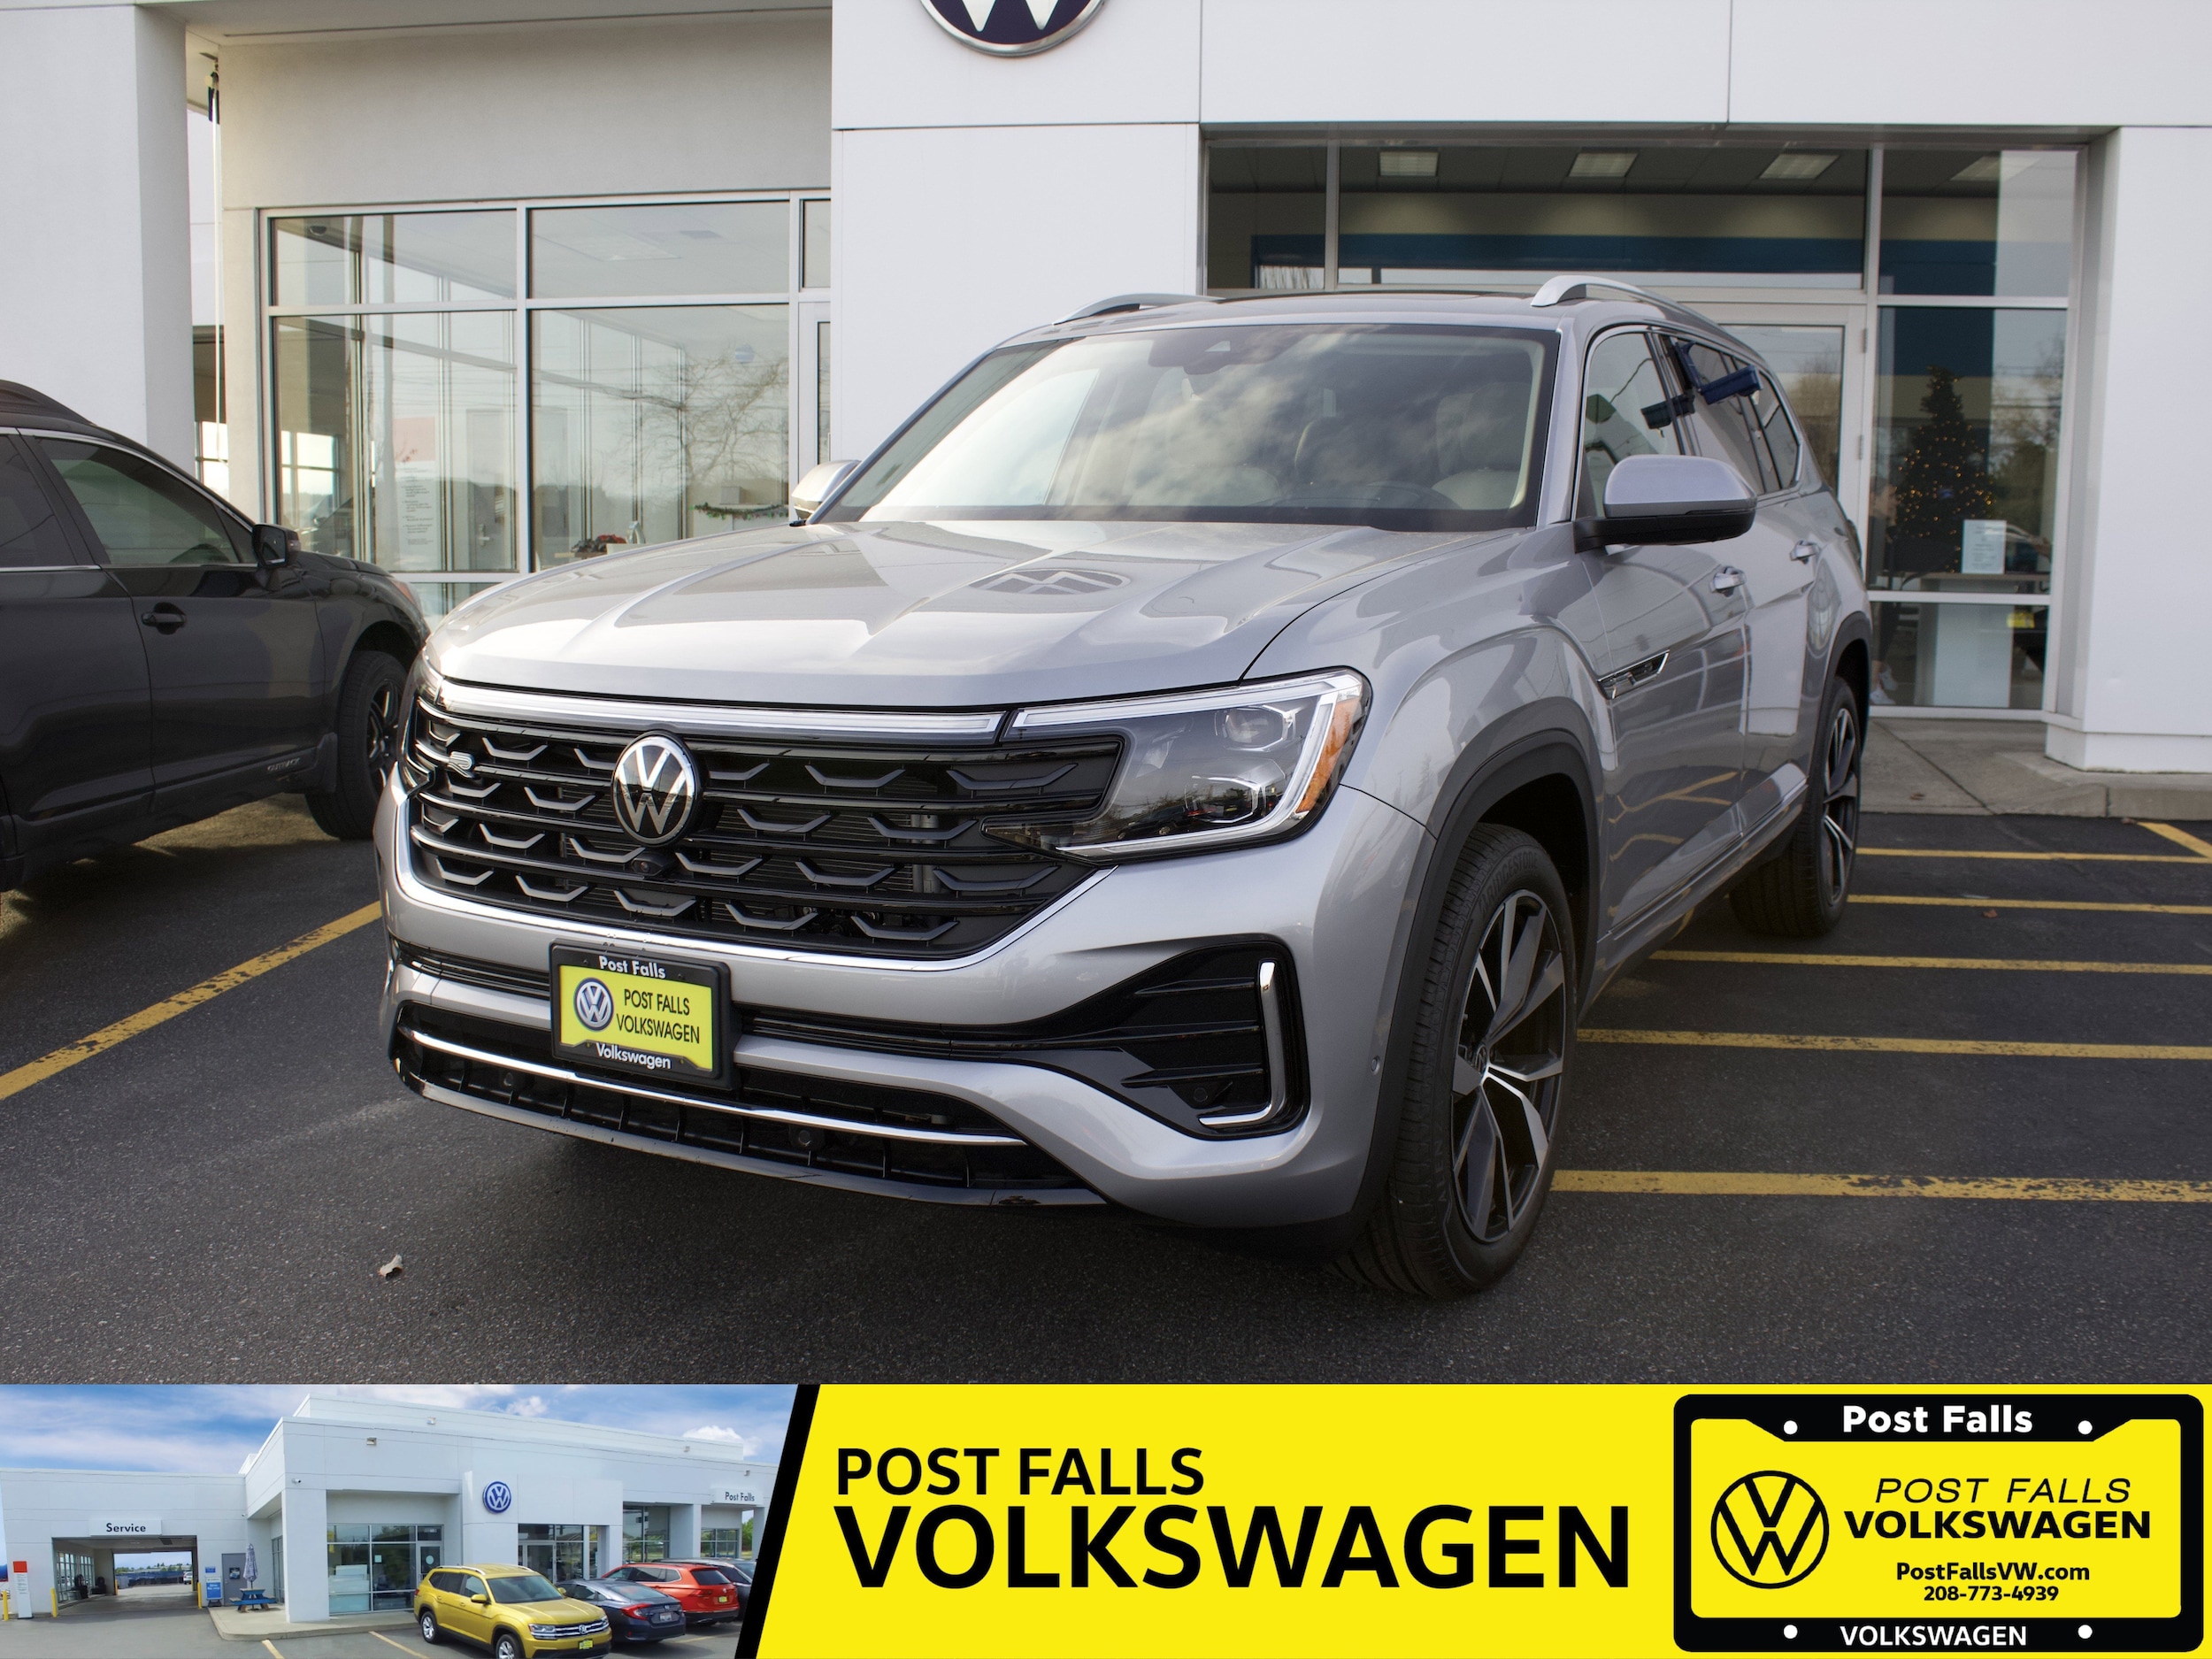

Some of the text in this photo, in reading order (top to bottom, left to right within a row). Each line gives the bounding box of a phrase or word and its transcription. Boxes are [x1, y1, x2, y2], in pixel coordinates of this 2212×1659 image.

[599, 956, 666, 979] Post Falls
[624, 988, 690, 1016] POST FALLS
[616, 1013, 700, 1044] VOLKSWAGEN
[596, 1042, 672, 1070] Volkswagen
